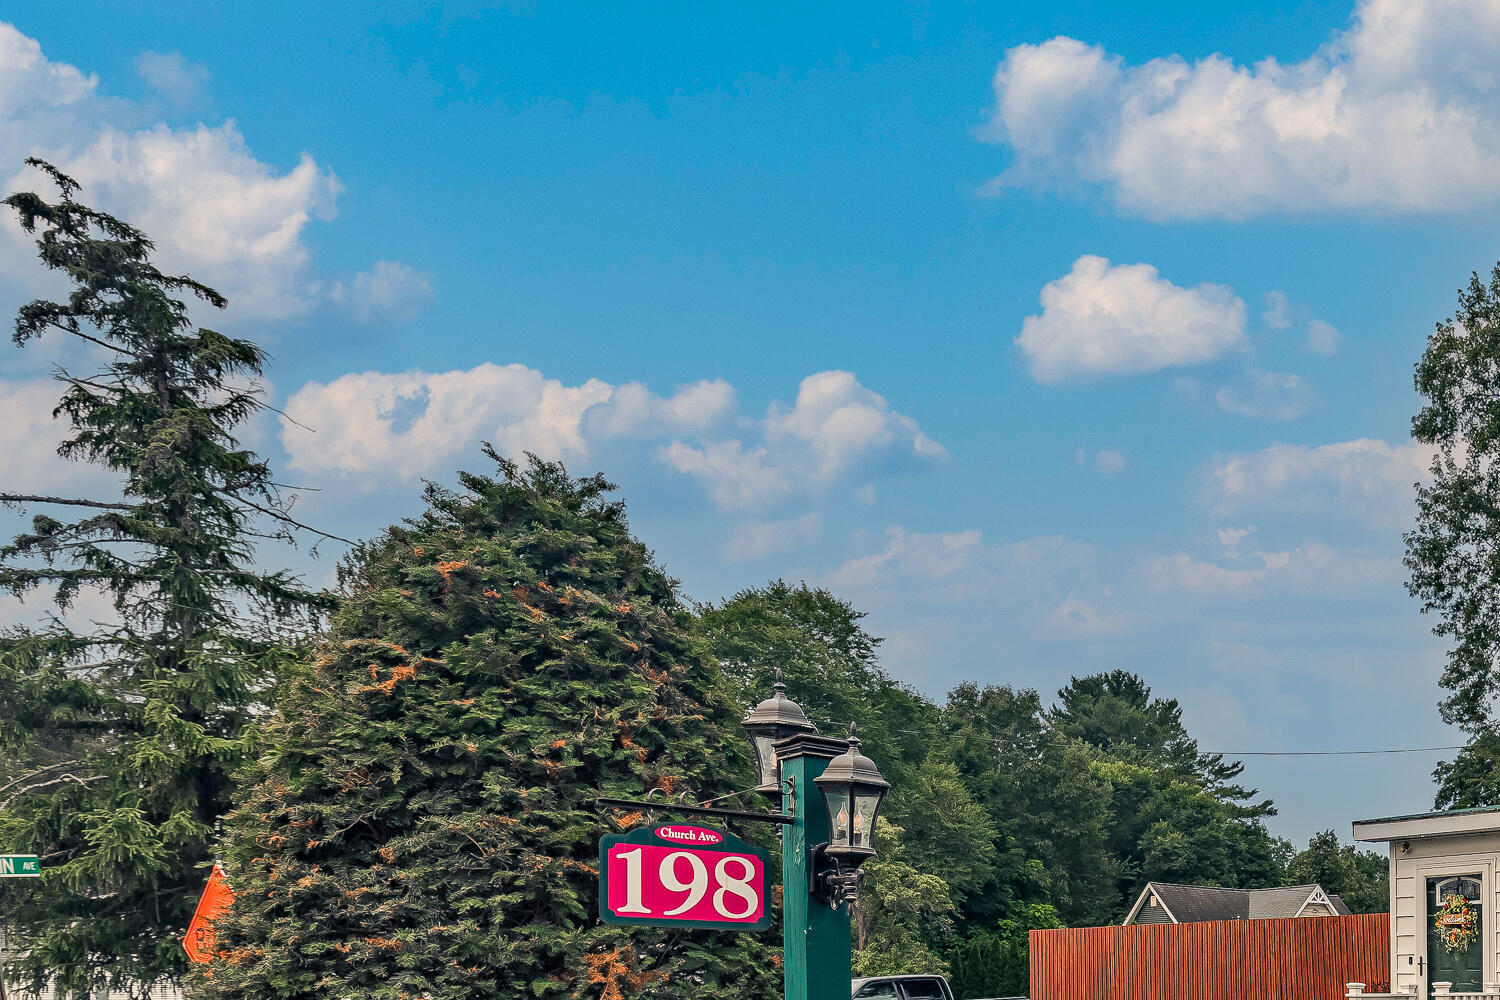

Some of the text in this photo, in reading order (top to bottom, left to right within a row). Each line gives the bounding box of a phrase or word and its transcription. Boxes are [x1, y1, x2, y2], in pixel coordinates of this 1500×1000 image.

[660, 827, 719, 842] Church Ave.
[22, 862, 36, 870] AVE
[616, 848, 759, 919] 198
